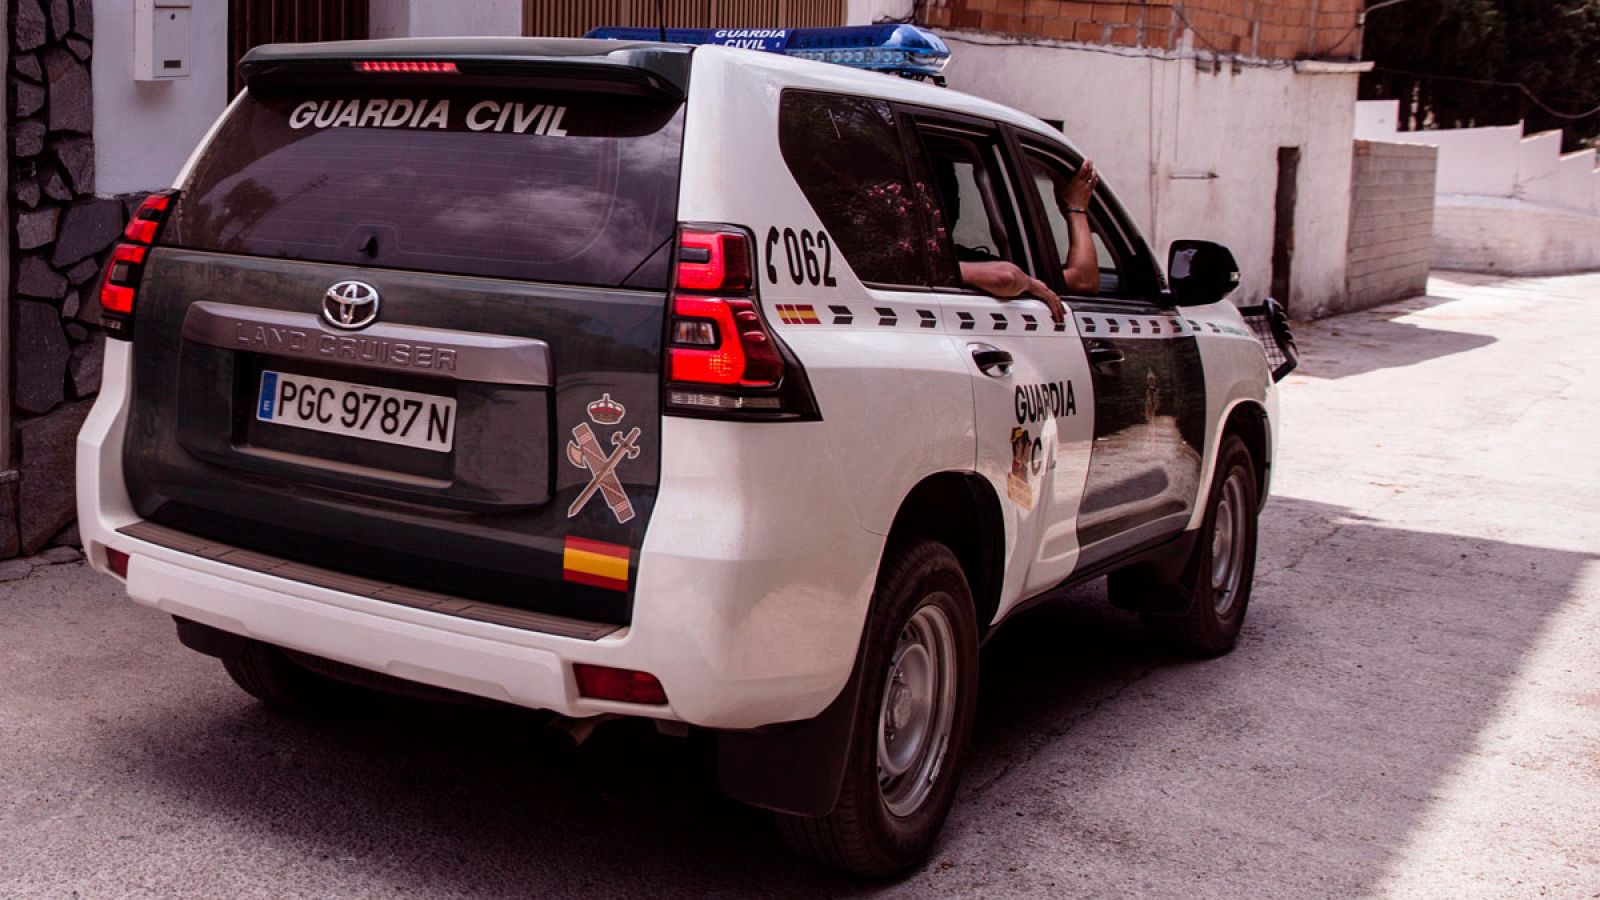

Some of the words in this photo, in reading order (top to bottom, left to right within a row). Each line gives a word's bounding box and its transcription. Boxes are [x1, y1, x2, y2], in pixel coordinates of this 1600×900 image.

[715, 30, 785, 38] GUARDIA
[724, 39, 766, 49] CIVIL
[289, 100, 448, 129] GUARDIA
[466, 101, 568, 137] CIVIL
[783, 227, 837, 287] 062
[237, 323, 307, 347] LAND
[319, 335, 457, 370] CRUISER
[1015, 380, 1077, 425] GUARDIA
